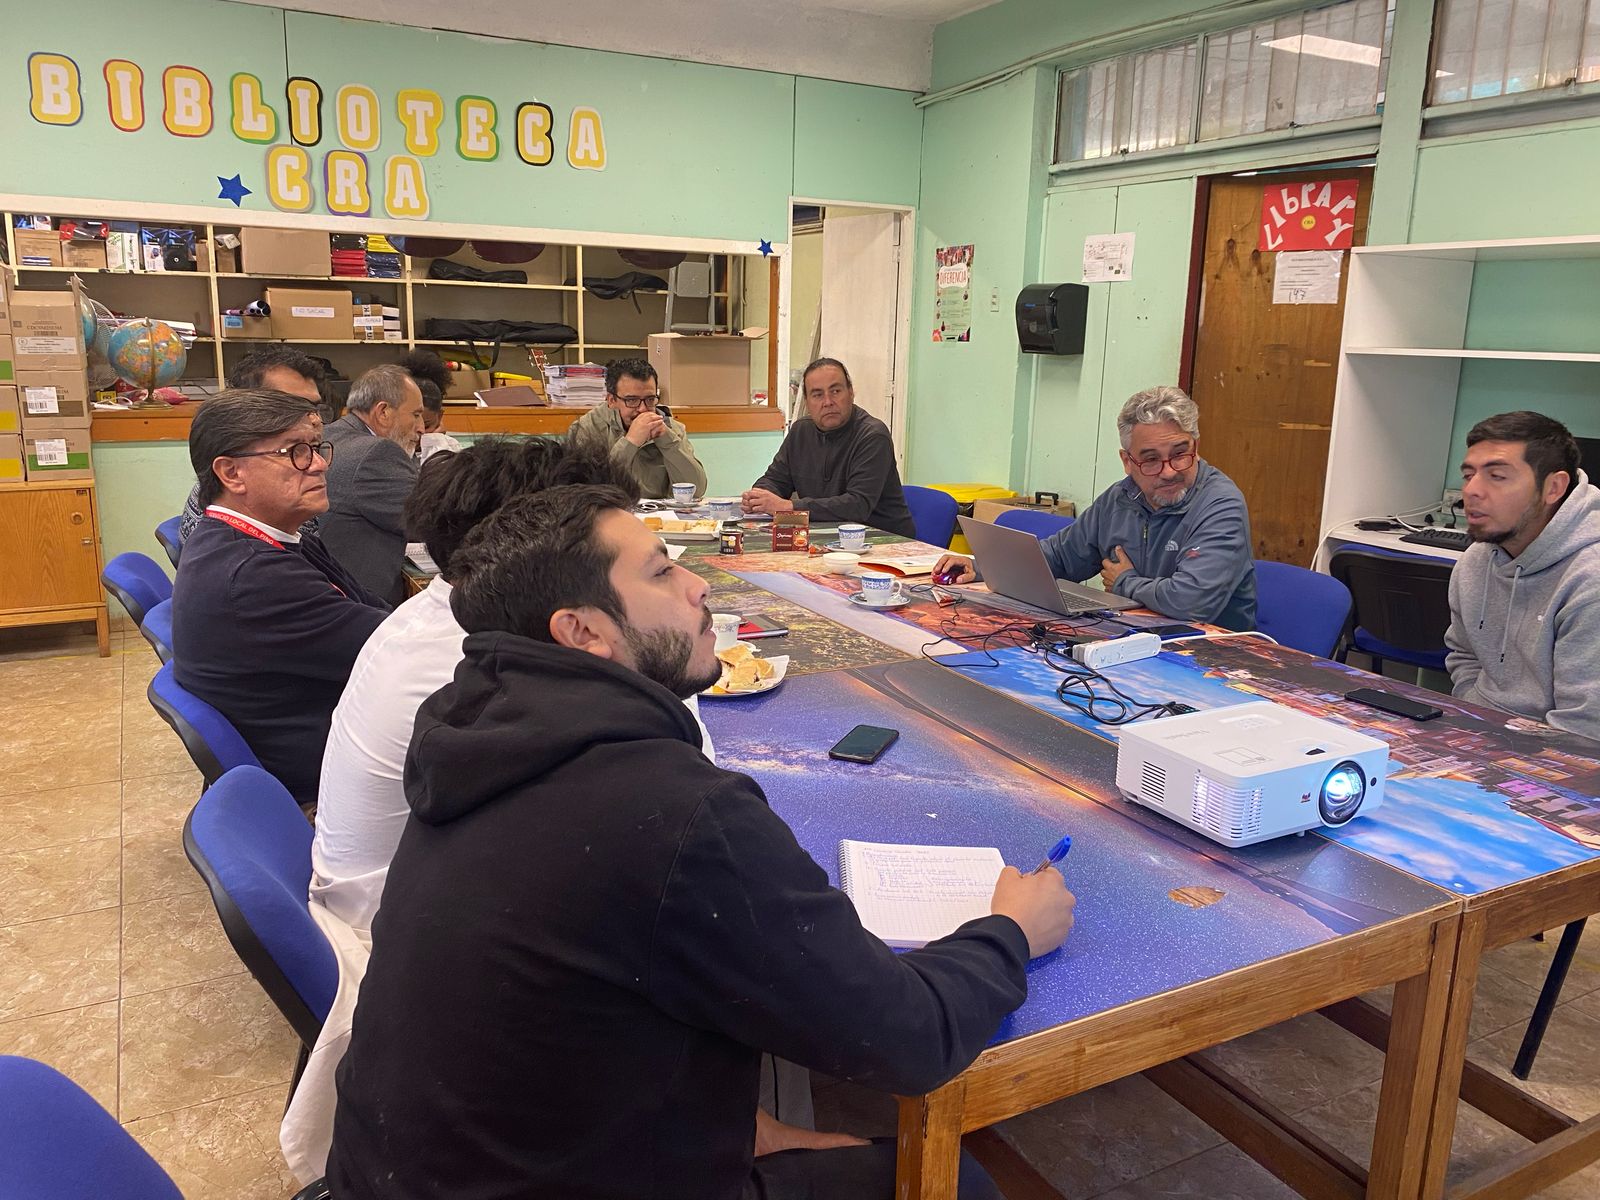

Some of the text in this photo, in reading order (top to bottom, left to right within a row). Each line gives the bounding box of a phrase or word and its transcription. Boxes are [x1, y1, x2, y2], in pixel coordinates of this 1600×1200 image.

[28, 52, 607, 171] BIBLIOTECA
[266, 144, 430, 220] CRA
[940, 271, 967, 284] DIFERENCIA
[229, 518, 248, 529] LOCAL
[249, 526, 259, 537] DEL
[260, 534, 274, 545] PINO
